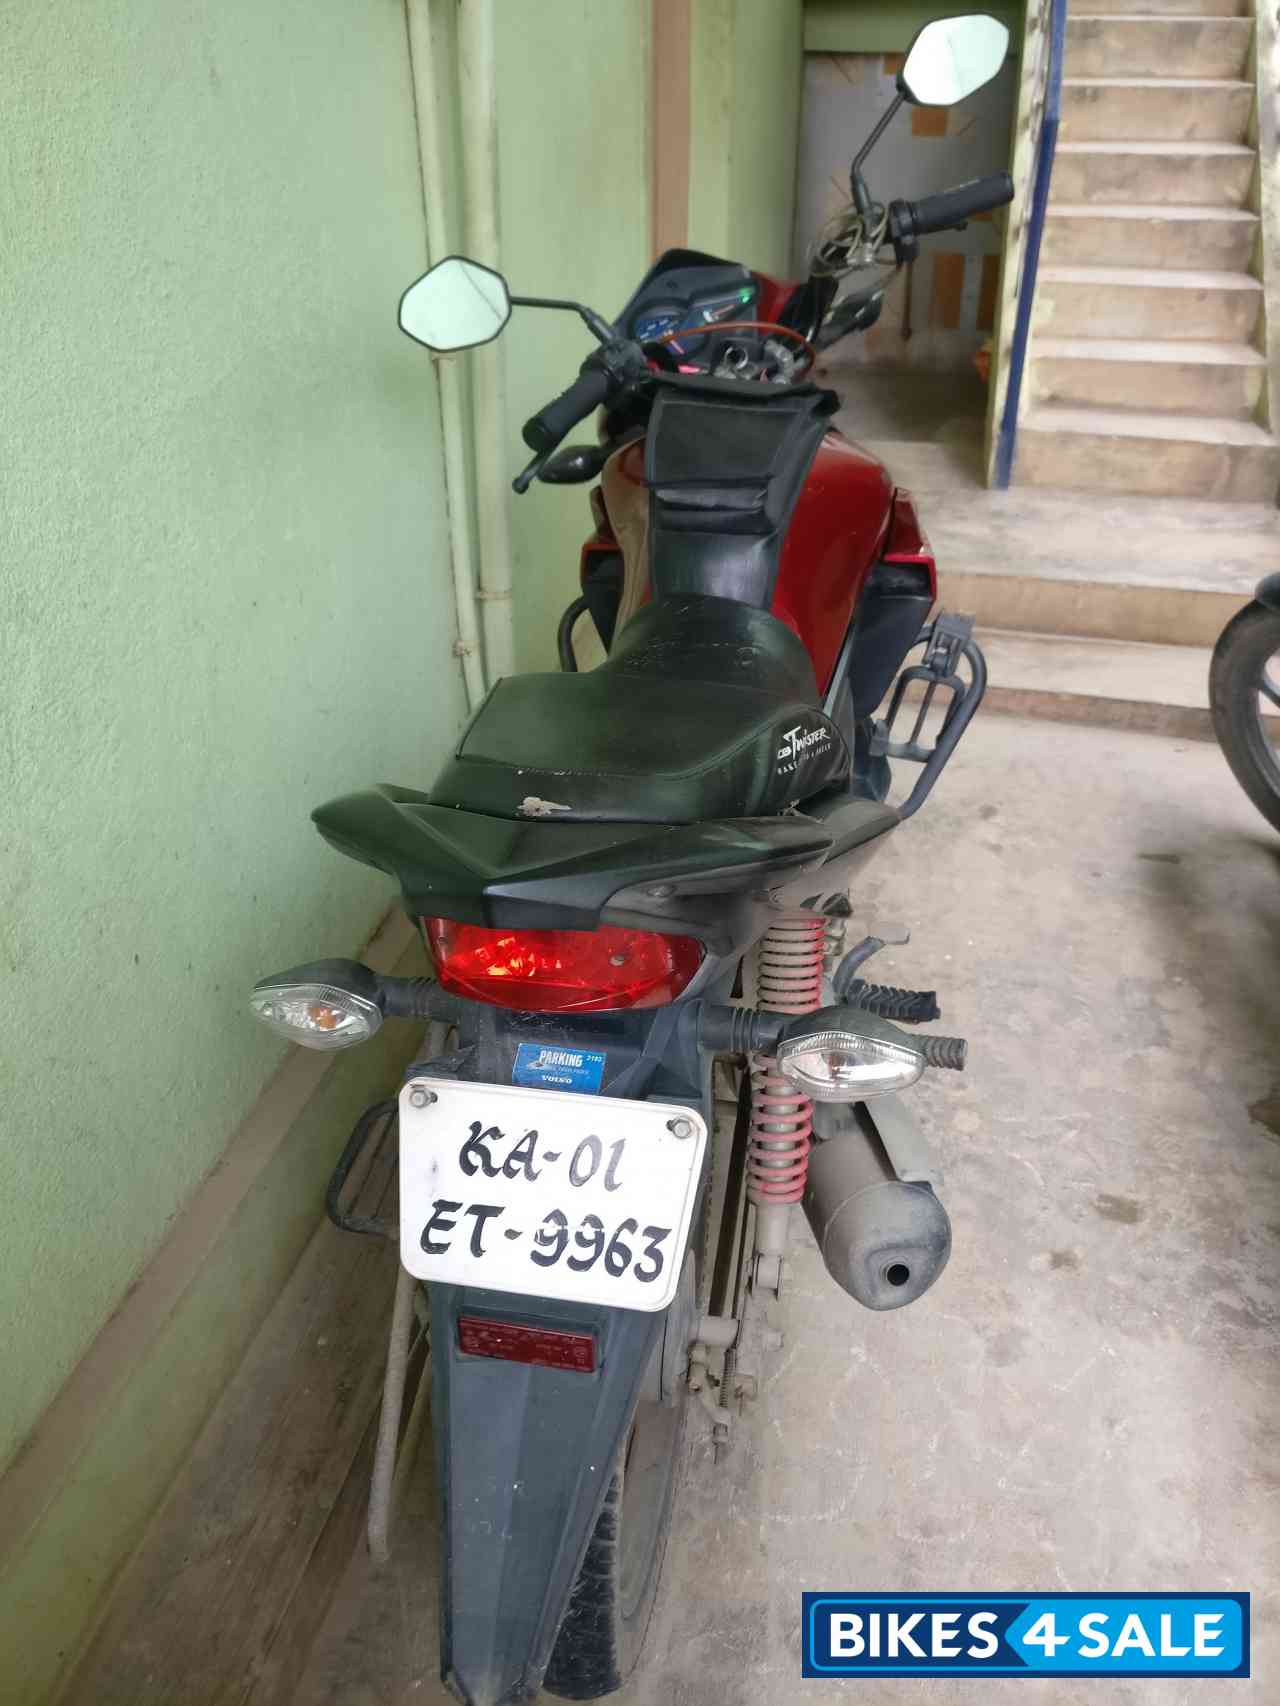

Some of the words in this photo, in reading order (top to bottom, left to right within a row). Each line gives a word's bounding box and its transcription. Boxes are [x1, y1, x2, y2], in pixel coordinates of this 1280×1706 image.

[539, 1050, 583, 1067] PARKING
[542, 1075, 573, 1084] VOLVO
[459, 1121, 626, 1192] KA-01
[420, 1199, 672, 1283] ET-9963
